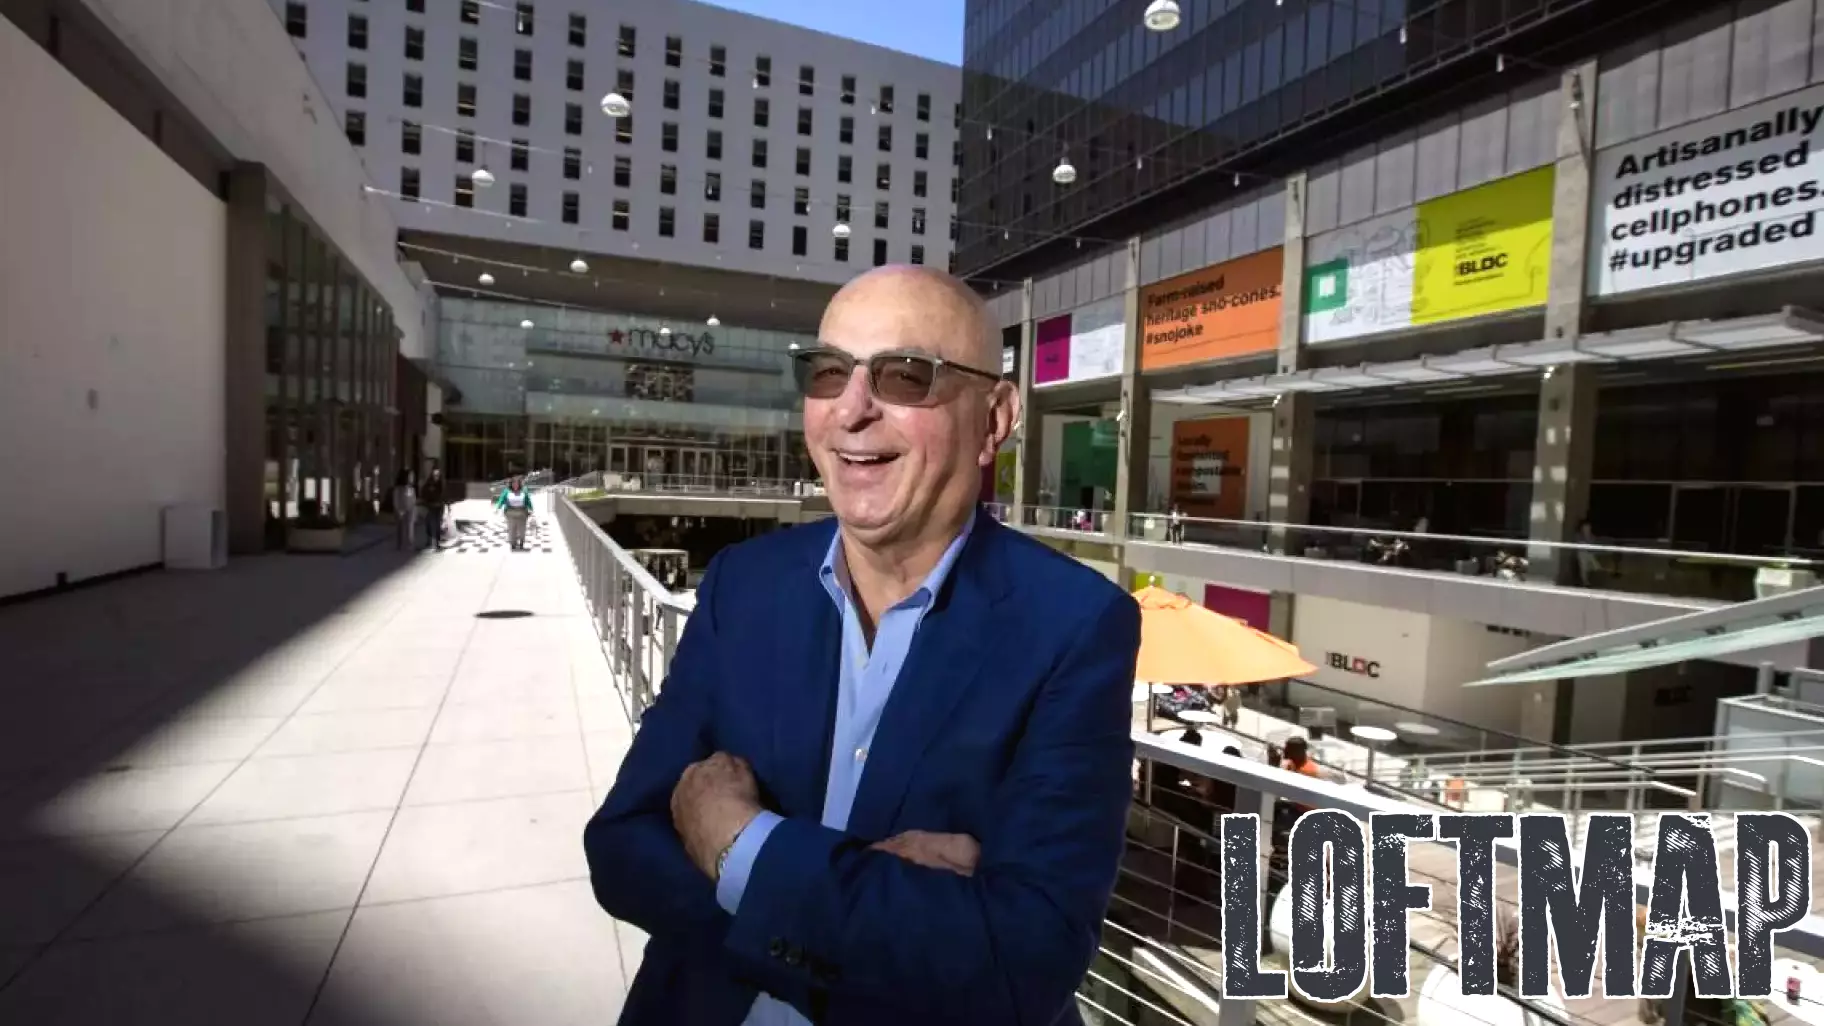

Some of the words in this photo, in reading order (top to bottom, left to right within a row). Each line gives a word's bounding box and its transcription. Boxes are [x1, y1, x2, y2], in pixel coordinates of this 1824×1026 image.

[1616, 105, 1824, 179] Artisanally
[1613, 140, 1810, 209] distressed
[1609, 211, 1814, 271] #upgraded
[1146, 304, 1198, 326] heritage
[1146, 323, 1203, 345] #snojoke
